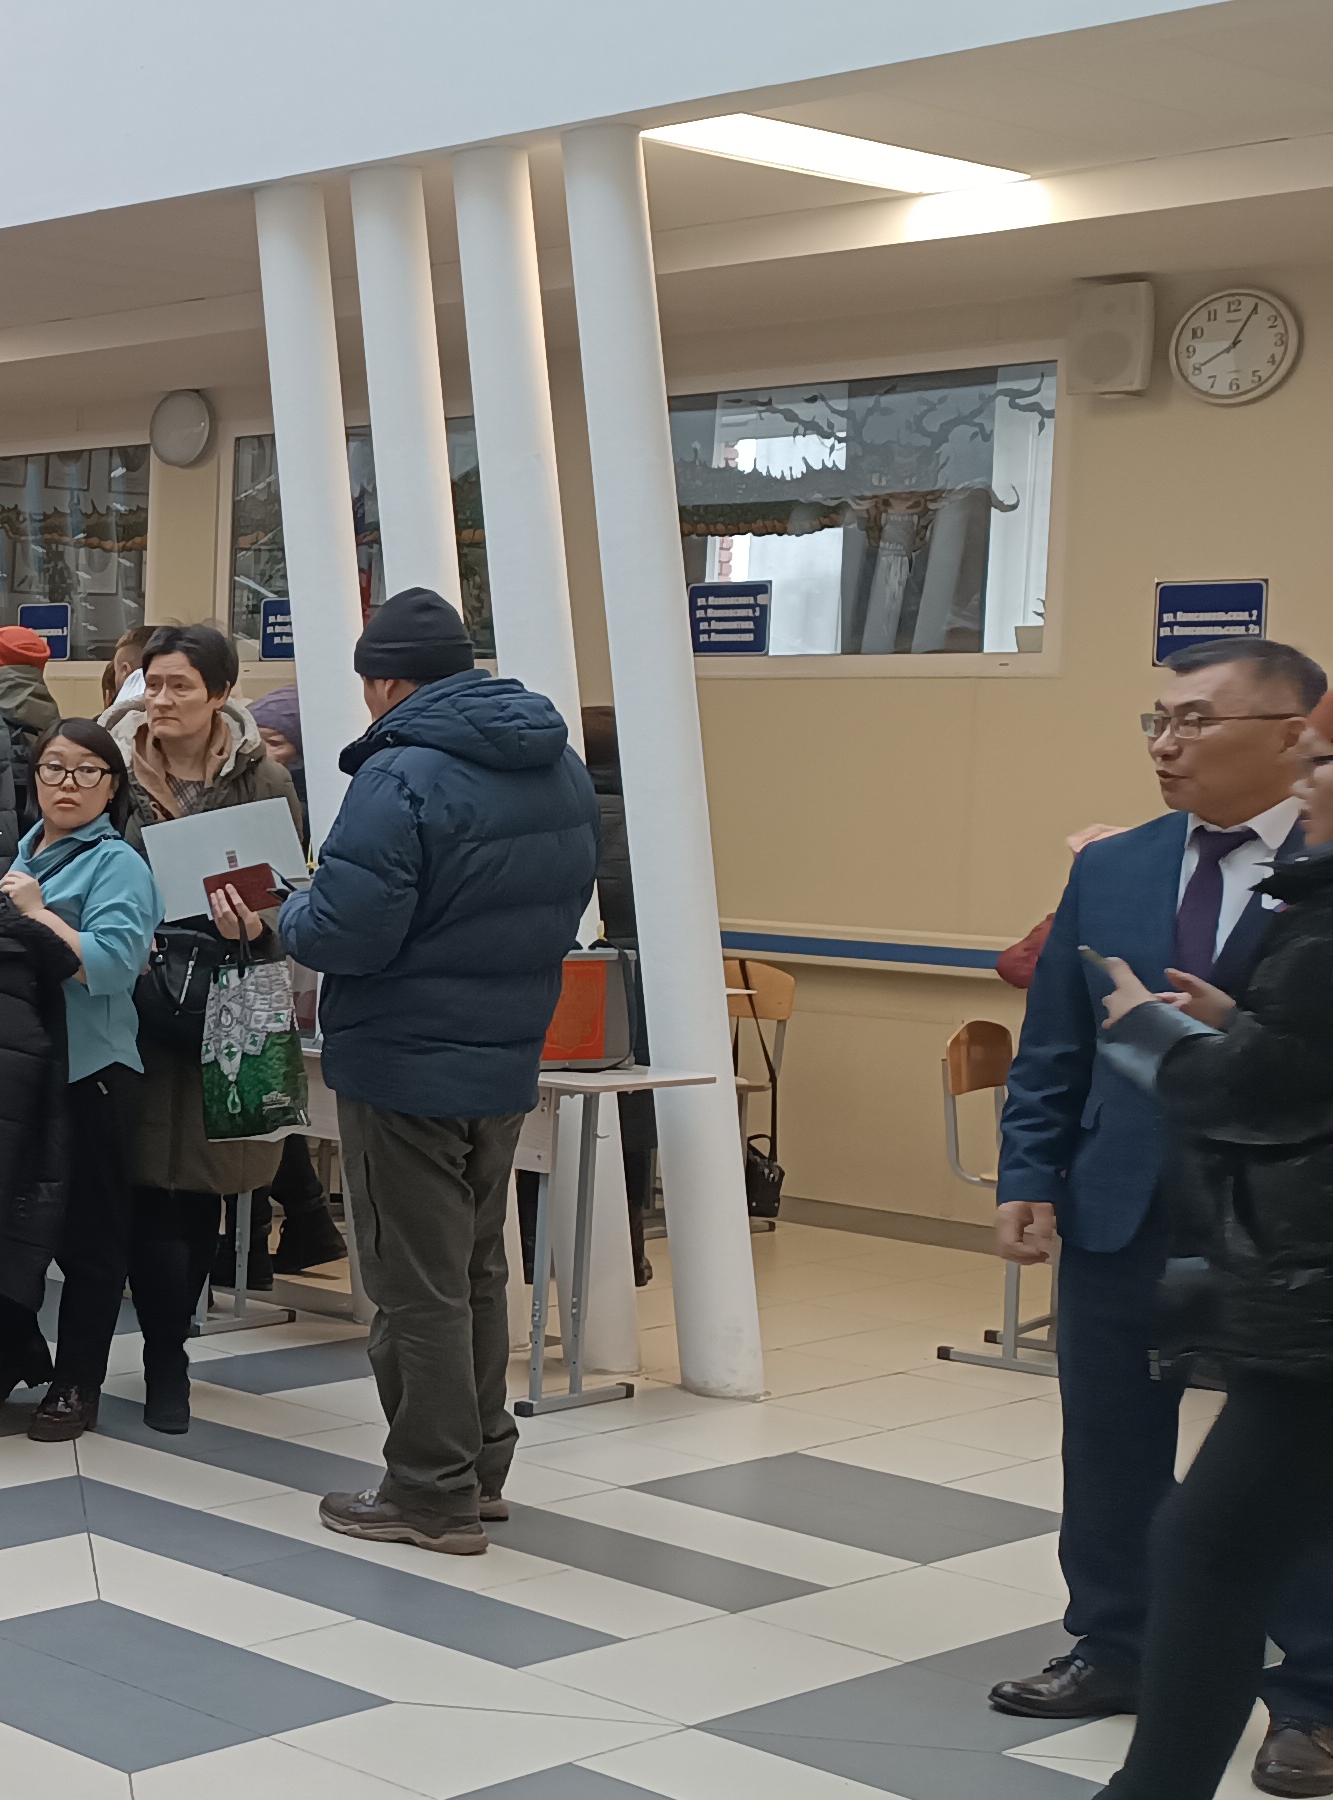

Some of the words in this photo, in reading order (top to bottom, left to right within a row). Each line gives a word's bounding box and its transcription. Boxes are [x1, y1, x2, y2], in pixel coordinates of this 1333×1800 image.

[1227, 299, 1242, 313] 12
[1206, 309, 1218, 322] 11
[1267, 315, 1278, 329] 2
[1191, 326, 1204, 340] 10
[1274, 333, 1285, 347] 3
[1186, 345, 1196, 359] 9
[1266, 353, 1276, 366] 4
[1192, 362, 1202, 376] 8
[1207, 375, 1217, 389] 7
[1251, 370, 1262, 384] 5
[1229, 378, 1240, 392] 6
